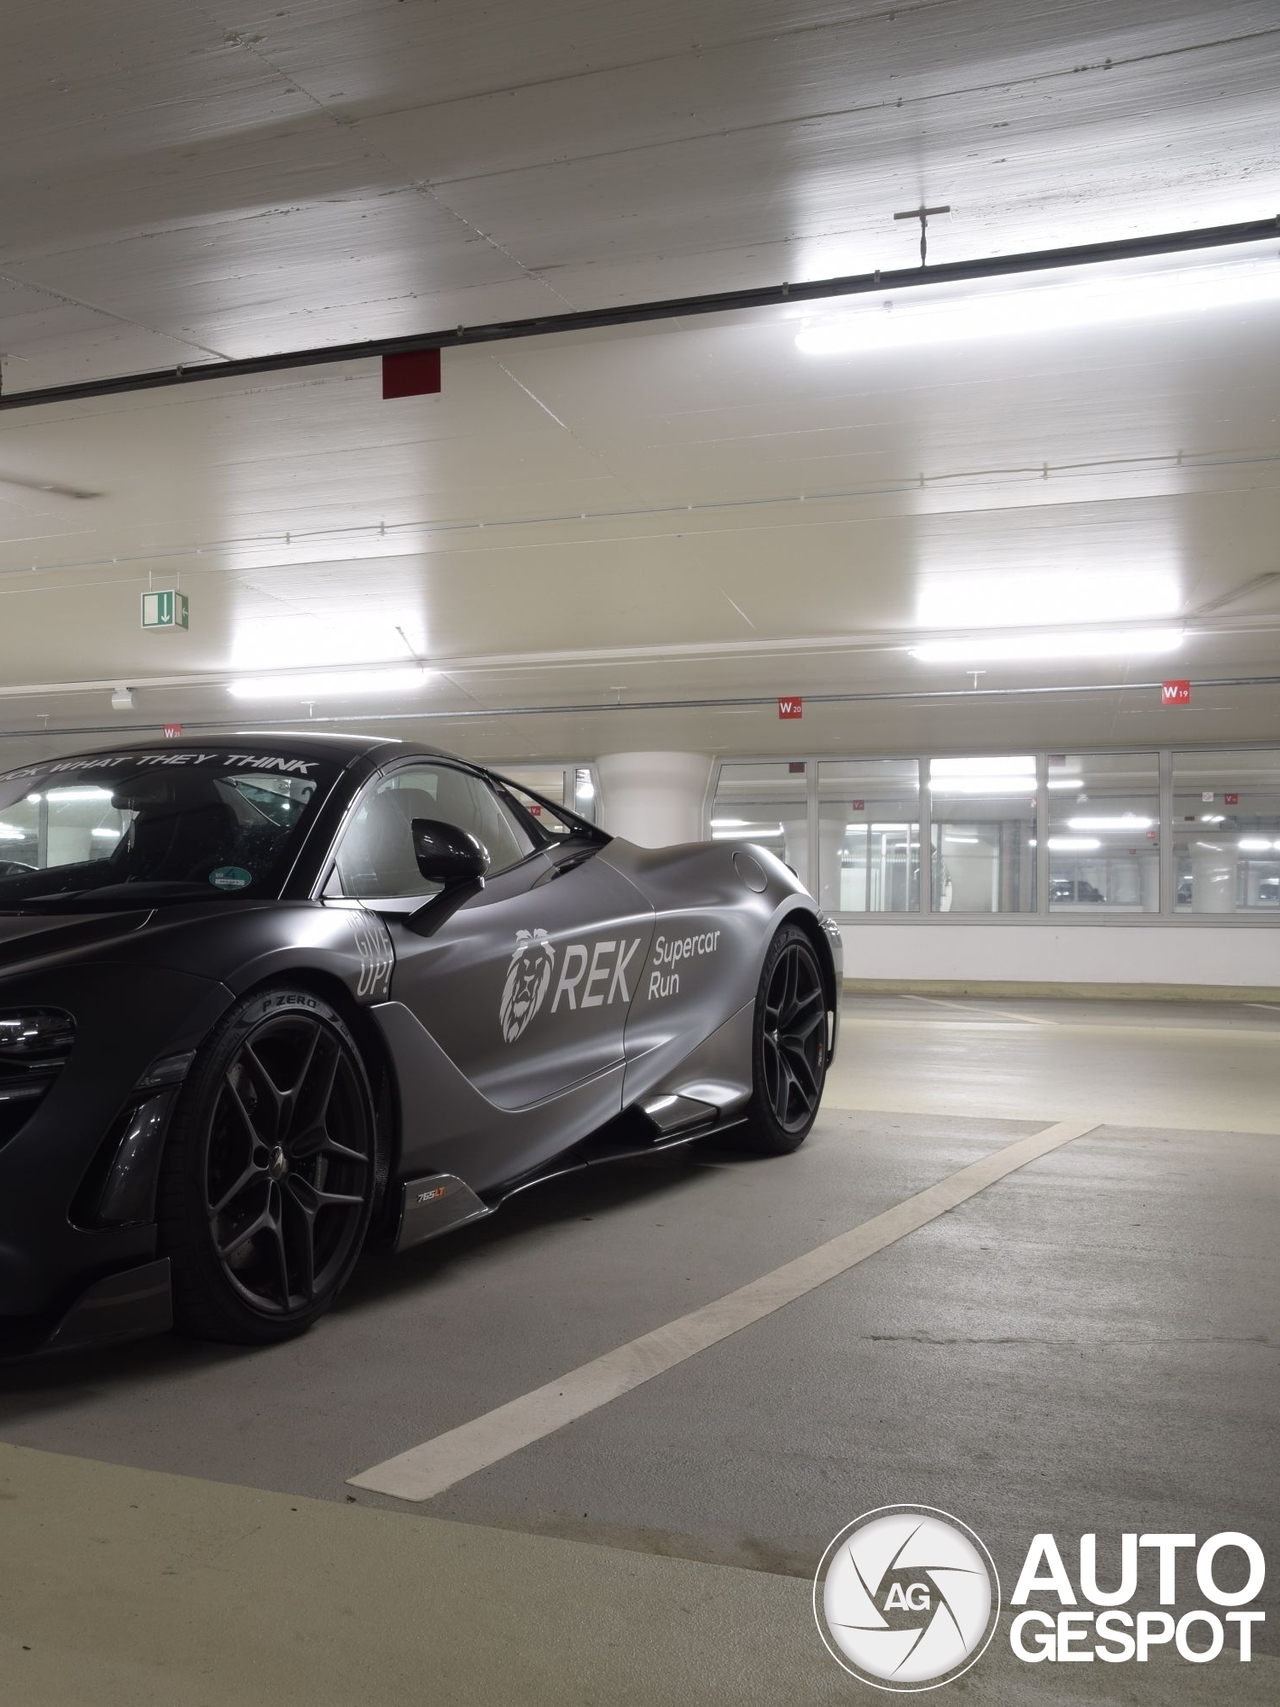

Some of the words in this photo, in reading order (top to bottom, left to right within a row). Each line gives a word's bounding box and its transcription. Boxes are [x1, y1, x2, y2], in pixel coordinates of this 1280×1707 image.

[1164, 686, 1178, 698] W
[1179, 690, 1188, 698] 19
[780, 702, 792, 713] W
[165, 728, 174, 738] W
[49, 756, 134, 773] WHAT
[135, 754, 220, 766] THEY
[223, 754, 320, 774] THINK
[354, 927, 389, 959] GIVE
[653, 930, 721, 969] Supercar
[357, 960, 392, 996] UP!
[550, 938, 642, 1013] REK
[648, 971, 680, 1000] Run
[262, 999, 272, 1013] P
[276, 994, 317, 1009] ZERO
